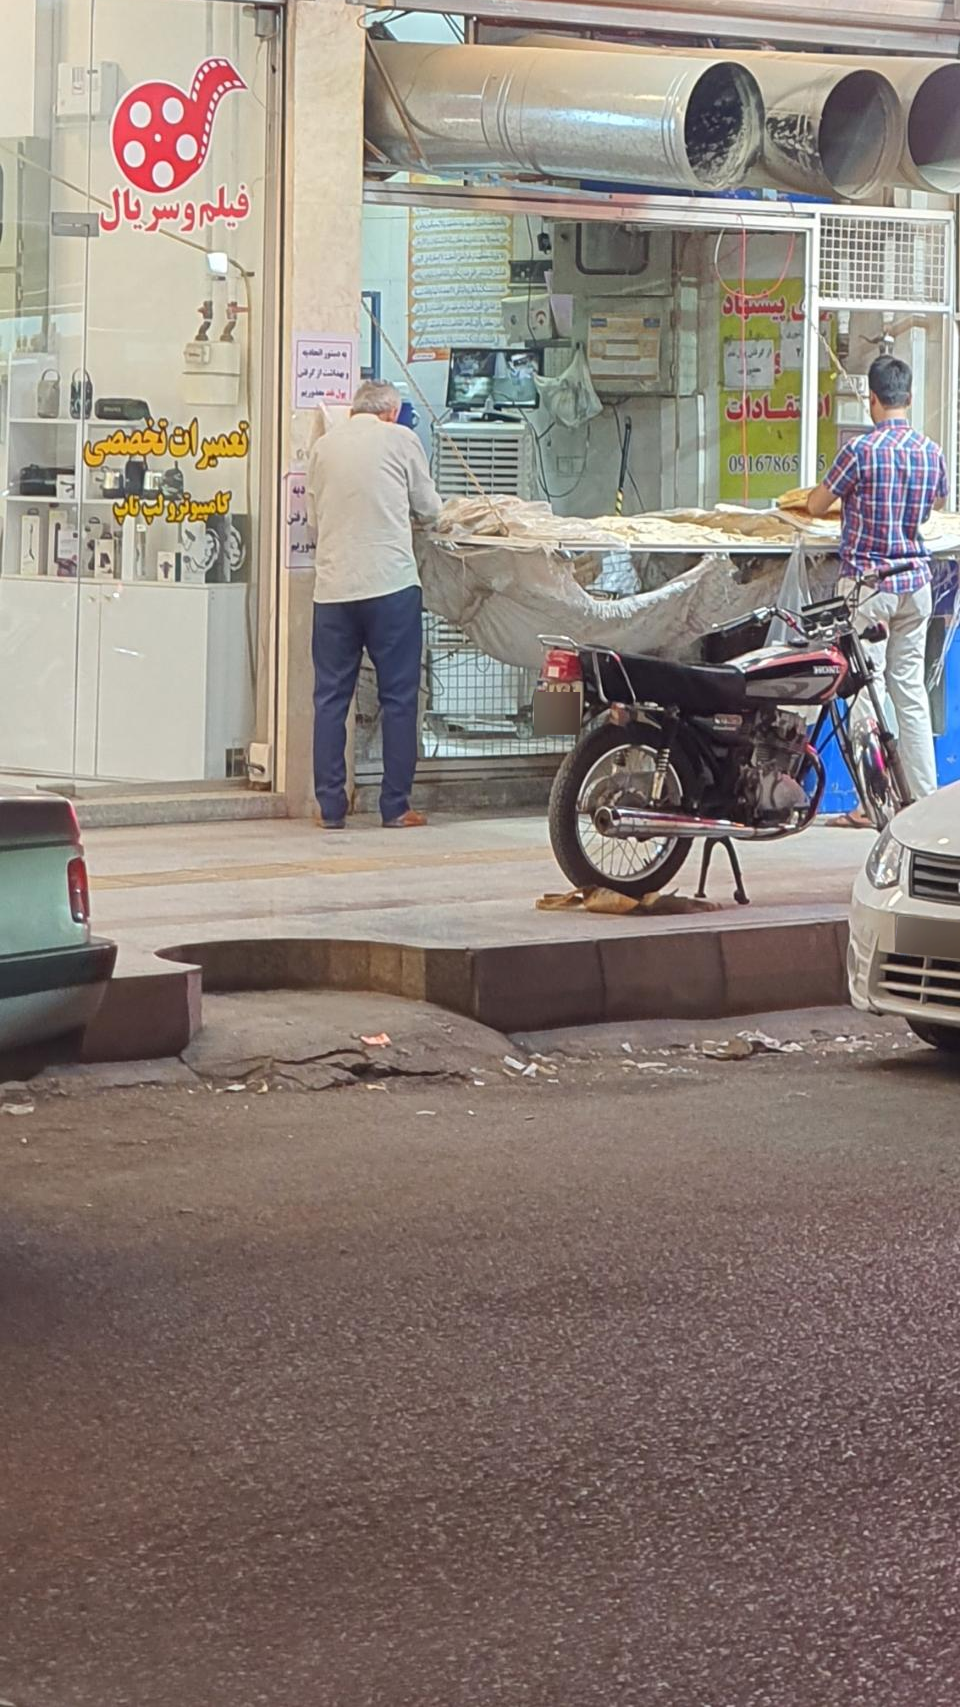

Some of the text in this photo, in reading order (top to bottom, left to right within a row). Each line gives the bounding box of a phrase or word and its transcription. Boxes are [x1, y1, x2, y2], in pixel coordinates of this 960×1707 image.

[100, 184, 250, 232] فیلم و سریال
[722, 289, 786, 321] پیشنهاد
[83, 416, 250, 471] تعمیرات تخصصی
[112, 493, 141, 526] تاپ
[141, 491, 165, 526] لپ
